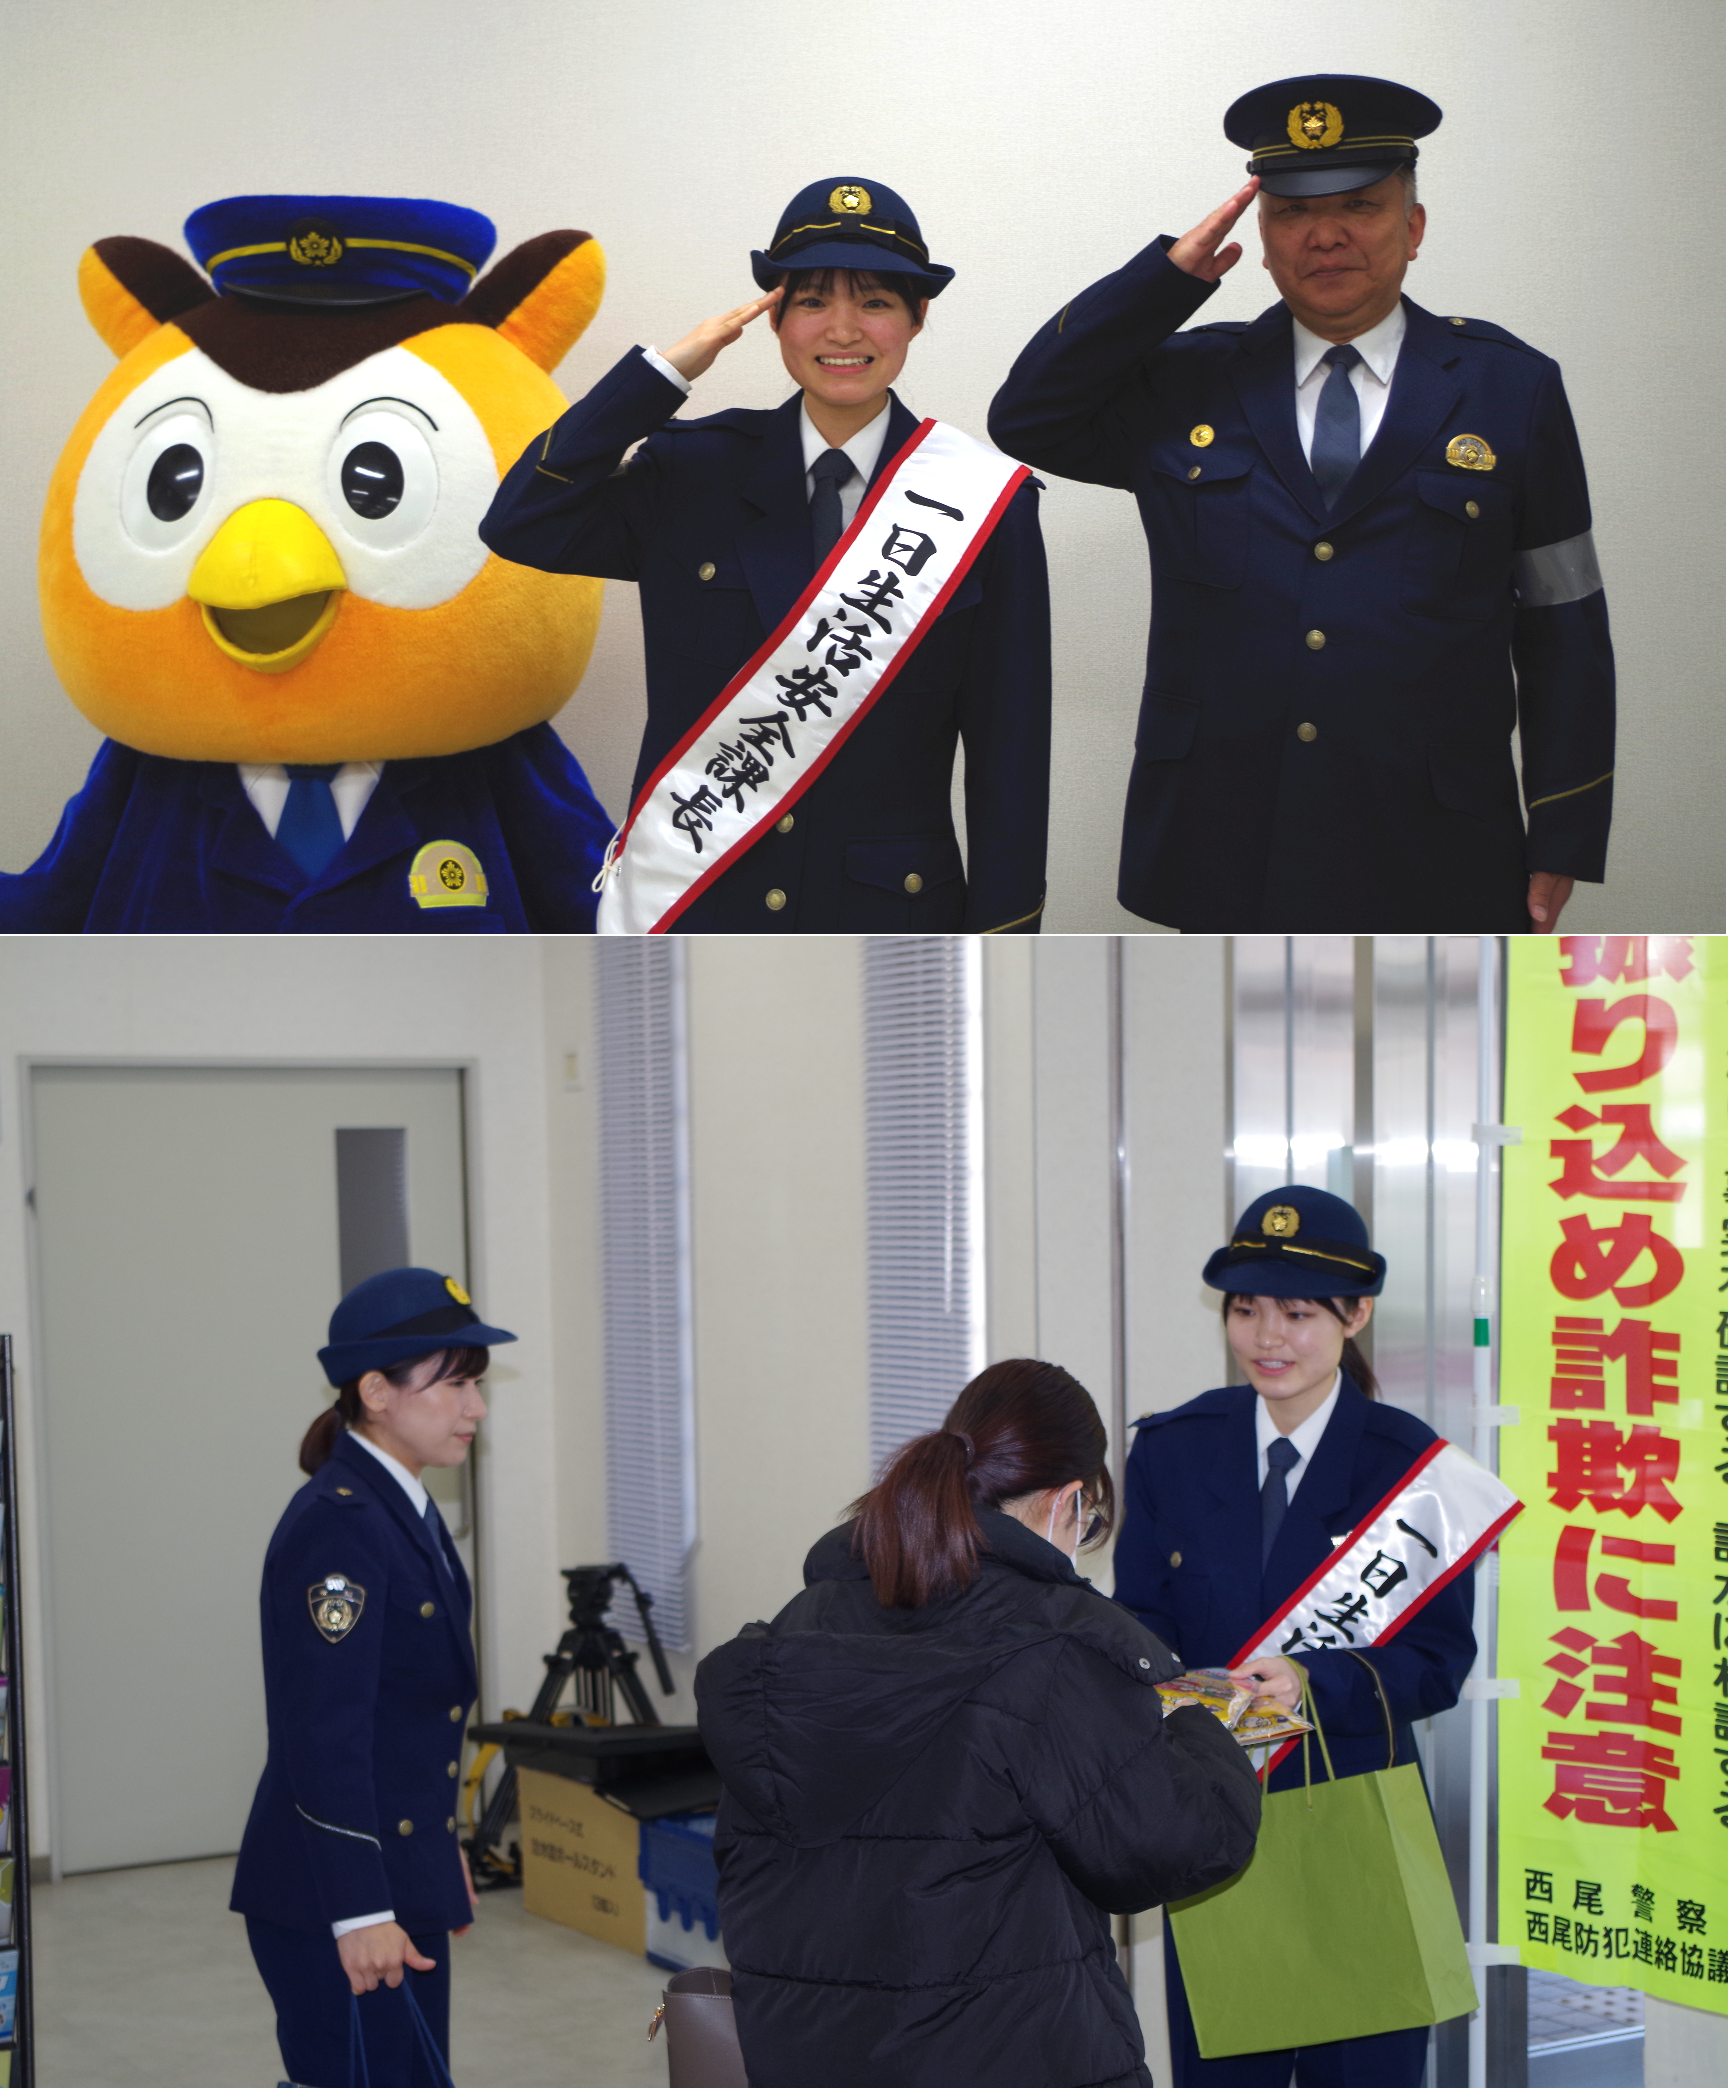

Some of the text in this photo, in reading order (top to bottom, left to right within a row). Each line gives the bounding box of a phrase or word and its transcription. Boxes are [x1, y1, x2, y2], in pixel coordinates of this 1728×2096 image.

[670, 490, 964, 853] 一日生活安全課長
